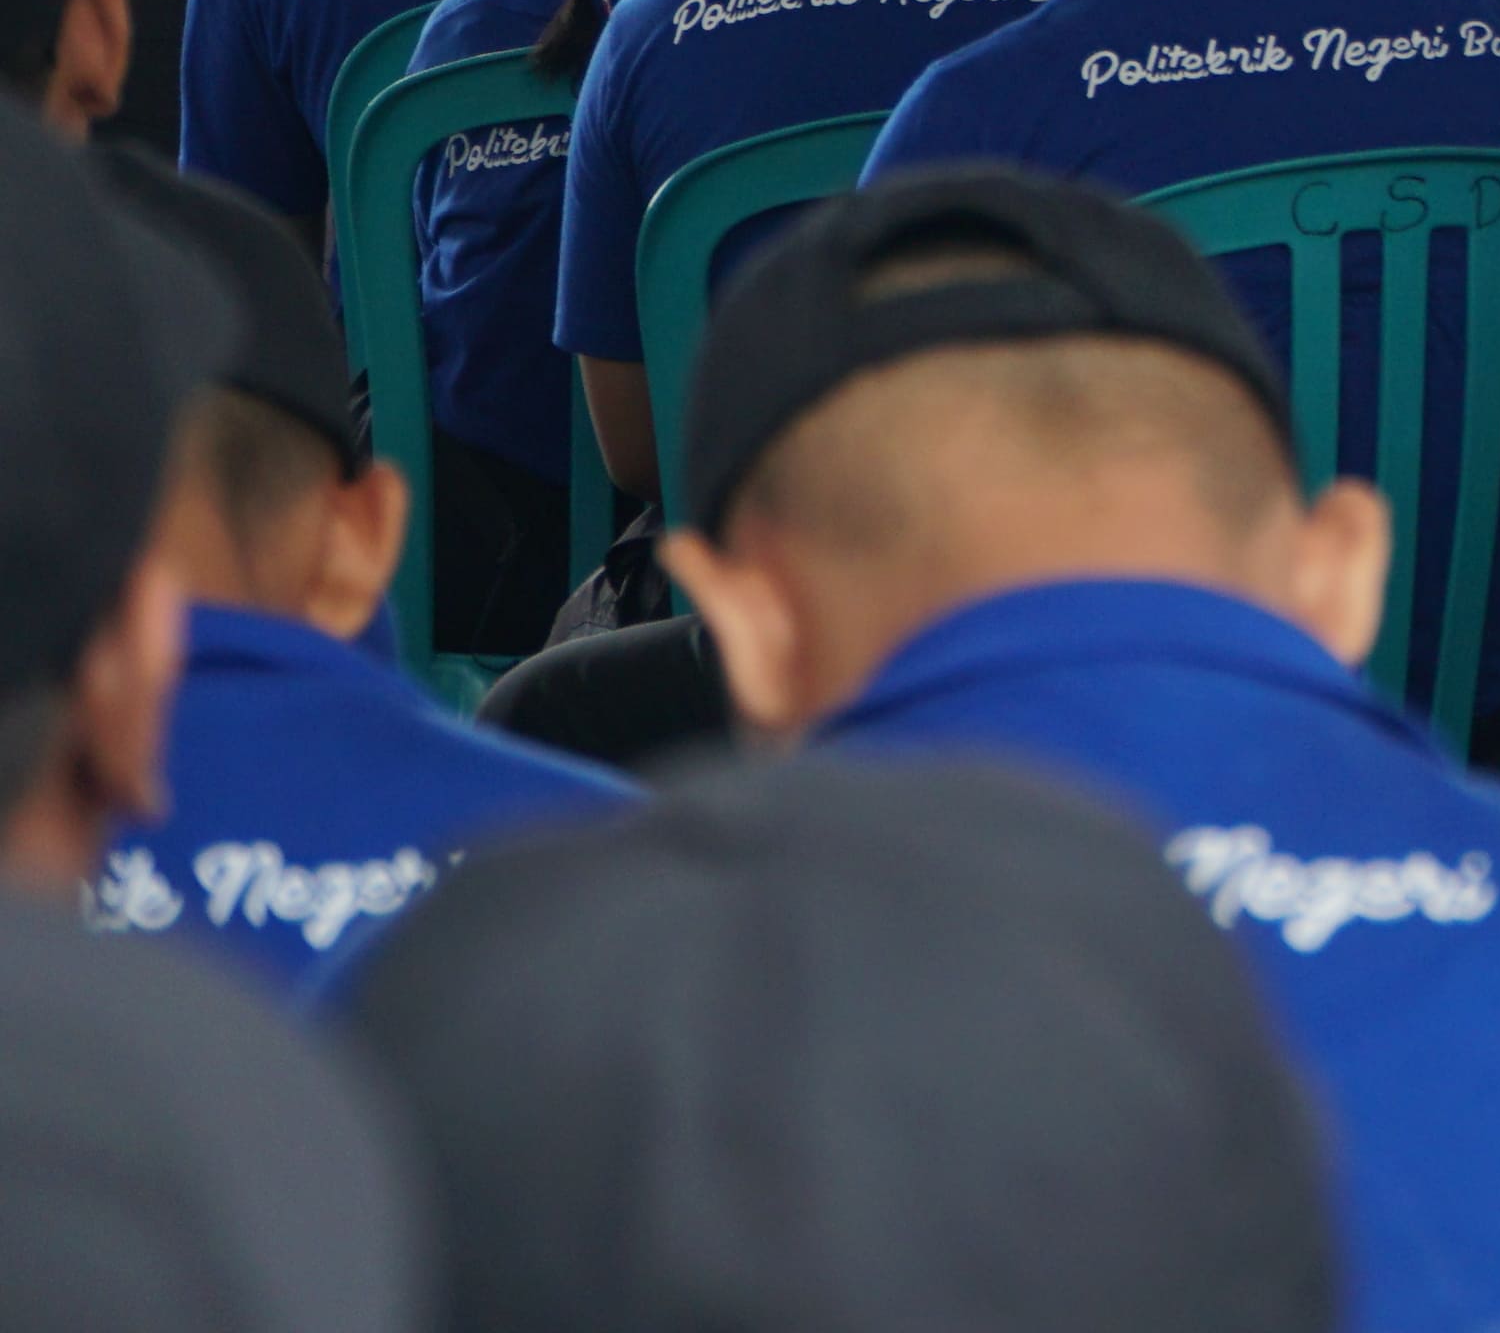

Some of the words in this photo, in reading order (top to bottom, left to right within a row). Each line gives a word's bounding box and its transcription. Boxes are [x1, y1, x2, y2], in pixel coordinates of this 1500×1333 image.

[1081, 35, 1294, 99] Politeknik
[1302, 26, 1450, 82] Negeri
[1164, 822, 1499, 954] Negeri
